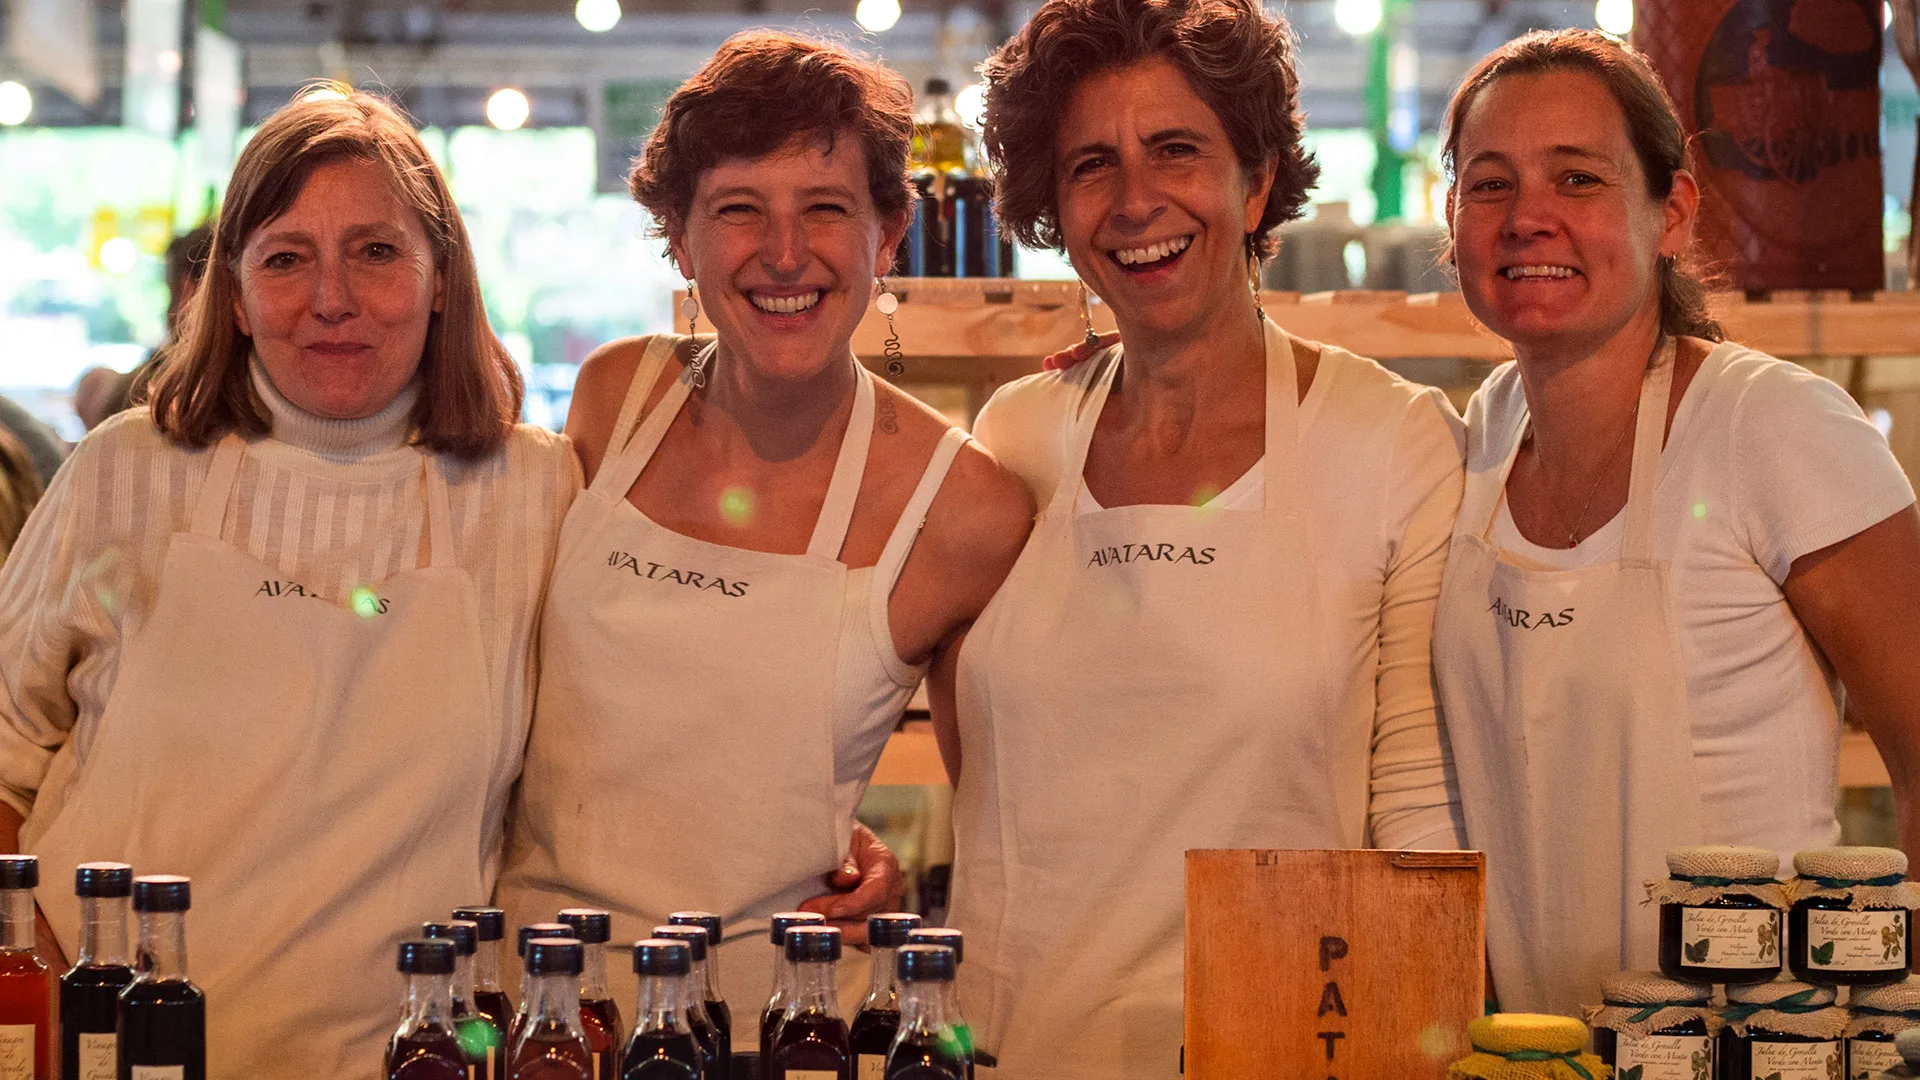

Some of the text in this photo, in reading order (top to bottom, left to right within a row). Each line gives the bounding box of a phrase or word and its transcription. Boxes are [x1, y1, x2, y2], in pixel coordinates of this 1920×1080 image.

[1087, 543, 1216, 569] AVATARAS
[254, 580, 390, 614] AVAAS
[1696, 923, 1714, 932] Verde
[1820, 926, 1838, 935] Verde
[1317, 935, 1349, 1080] PAT
[1767, 1056, 1786, 1065] Verde
